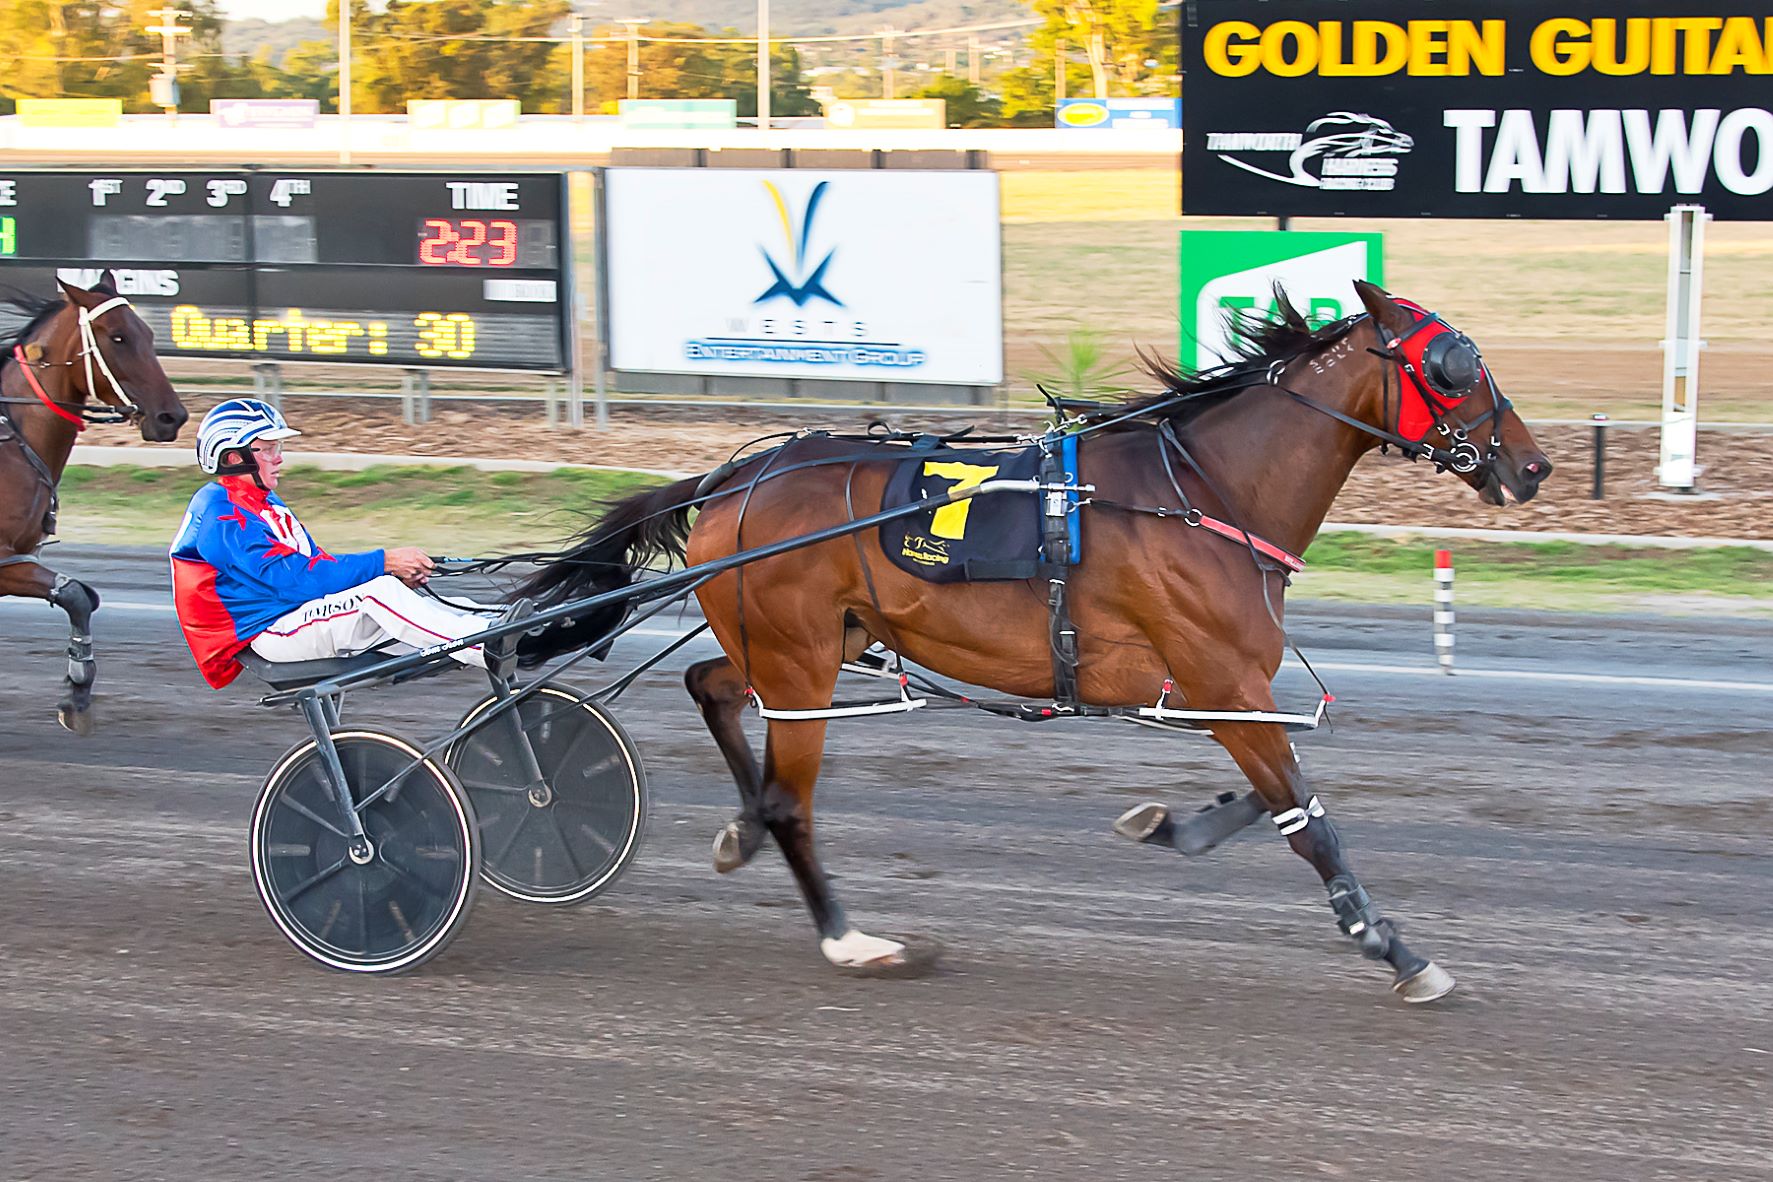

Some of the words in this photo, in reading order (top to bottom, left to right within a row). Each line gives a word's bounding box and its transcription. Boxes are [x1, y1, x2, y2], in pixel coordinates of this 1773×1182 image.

[1203, 19, 1506, 77] GOLDEN
[1444, 109, 1773, 195] TAMWO
[446, 182, 520, 211] TIME
[419, 219, 517, 265] 2:23
[415, 311, 476, 358] 30
[727, 318, 867, 337] WESTS
[922, 461, 1000, 540] 7
